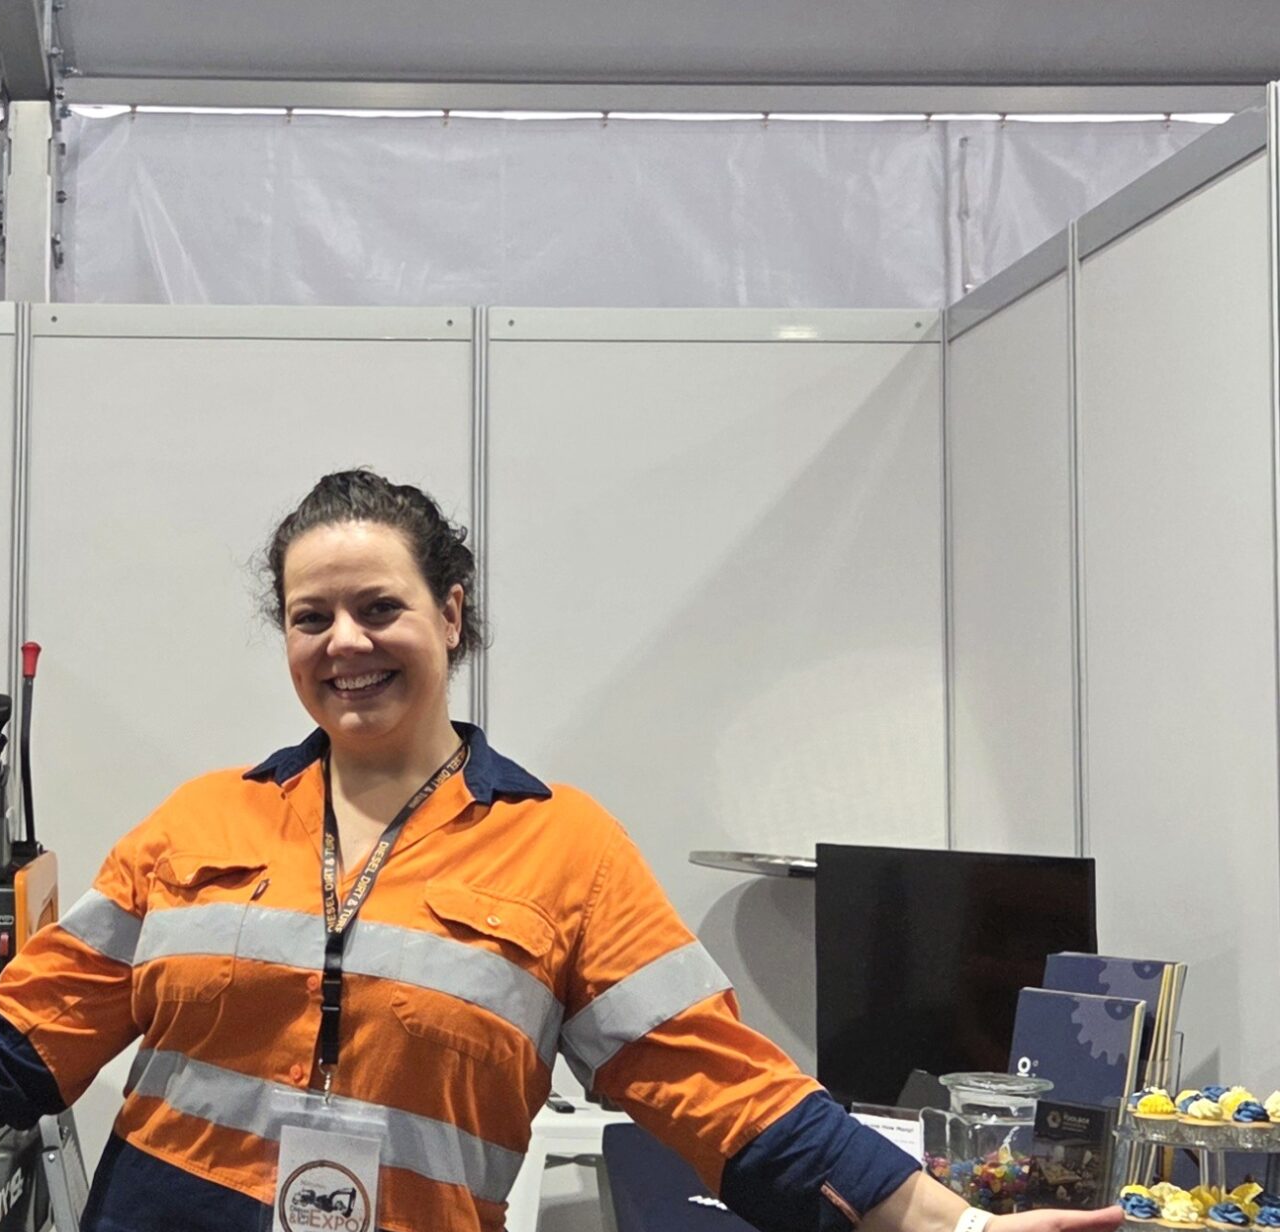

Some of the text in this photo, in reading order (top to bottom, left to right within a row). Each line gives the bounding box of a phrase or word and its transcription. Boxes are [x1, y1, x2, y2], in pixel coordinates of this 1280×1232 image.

[369, 841, 390, 873] DIESEL
[355, 876, 371, 898] DIRT
[334, 908, 353, 933] TURF
